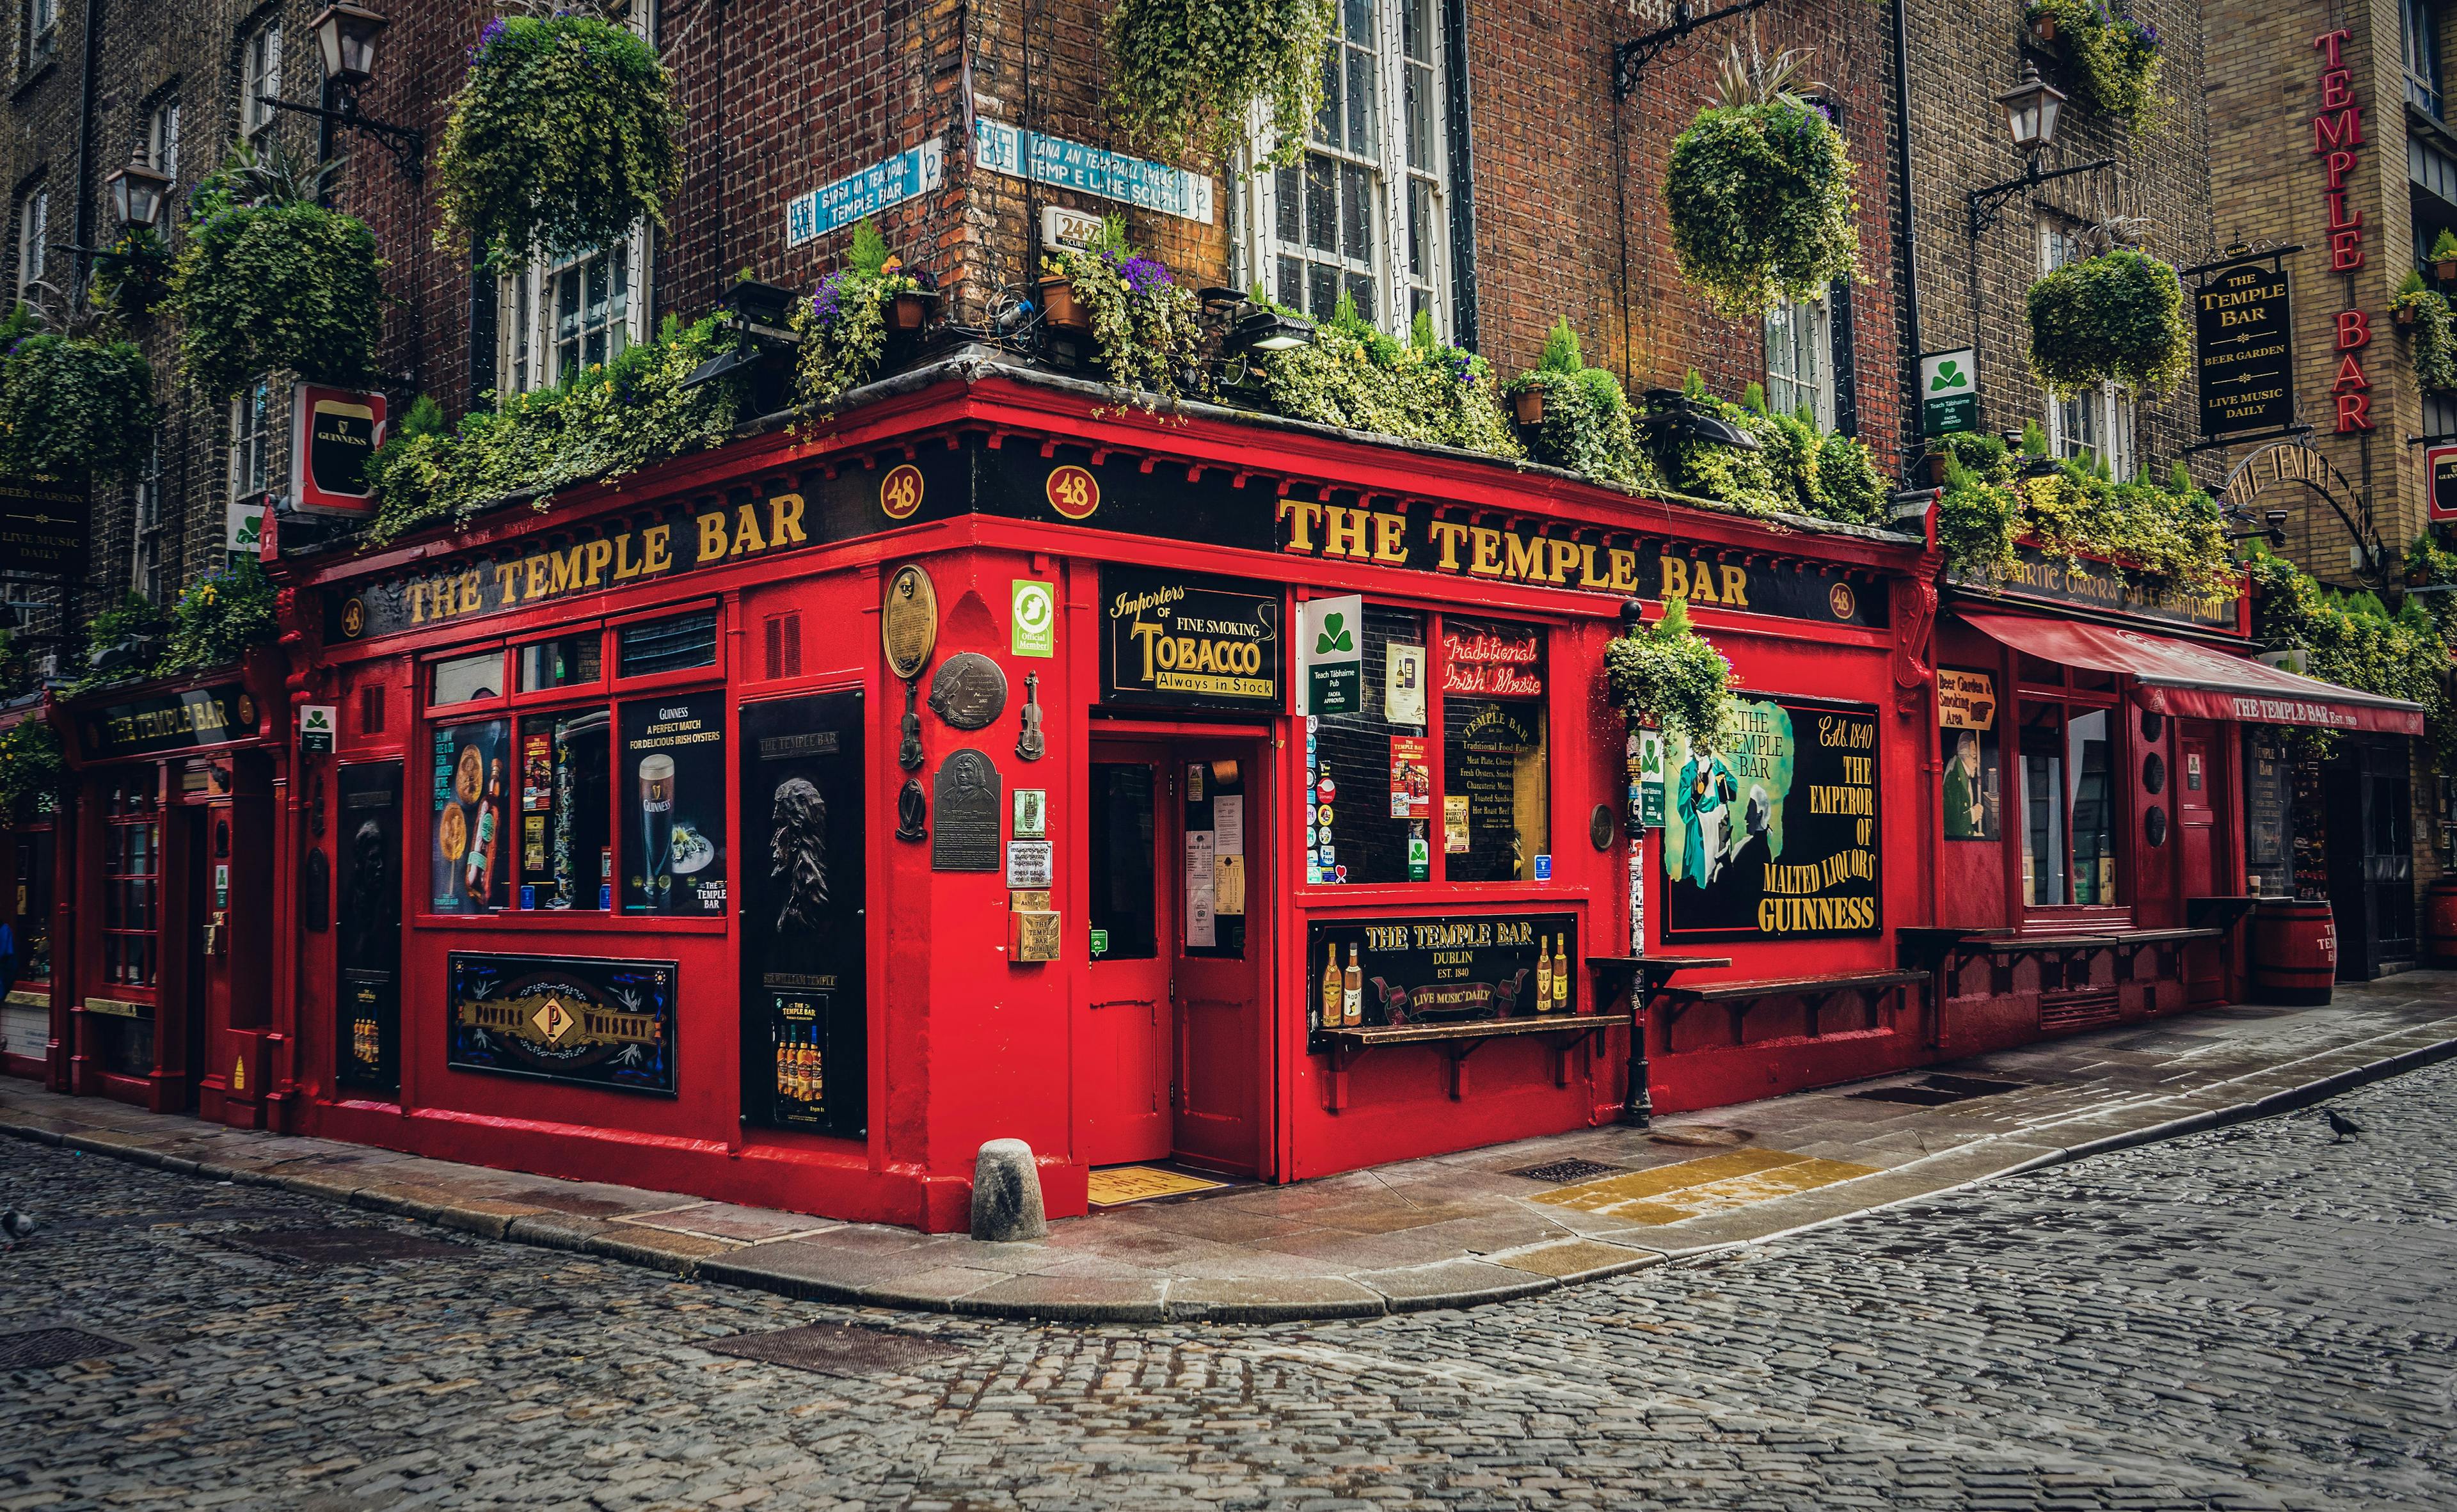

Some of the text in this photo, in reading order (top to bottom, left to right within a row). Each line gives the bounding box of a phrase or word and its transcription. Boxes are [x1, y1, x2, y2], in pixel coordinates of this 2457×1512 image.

[1031, 141, 1060, 160] LANA
[1065, 148, 1081, 164] AN
[926, 154, 937, 179] 2
[831, 194, 874, 223] TEMPLE
[1132, 186, 1179, 211] SOUTH
[1062, 218, 1098, 243] 24-7
[2310, 28, 2374, 434] TEMPLE BAR
[2227, 274, 2256, 287] THE
[2200, 283, 2286, 311] TEMPLE
[2221, 307, 2266, 327] BAR
[2204, 344, 2285, 366] BEER GARDEN
[2209, 388, 2283, 408] LIVE MUSIC
[2226, 404, 2266, 418] DAILY
[317, 432, 367, 446] GUINNESS
[2227, 458, 2264, 505] THE
[2268, 445, 2335, 492] TEMPLE
[0, 487, 84, 503] BEER GARDEN
[887, 475, 915, 509] 48
[1054, 476, 1089, 508] 48
[2, 532, 80, 548] LIVE MUSIC
[20, 548, 61, 560] DAILY
[406, 493, 807, 625] THE TEMPLE BAR
[1280, 499, 1749, 608] THE TEMPLE BAR
[1110, 585, 1184, 621] Importers
[1834, 590, 1850, 612] 48
[346, 606, 360, 629] 48
[1157, 608, 1170, 618] OF
[1022, 632, 1045, 642] Official
[1177, 617, 1260, 637] FINE SMOKING
[1019, 641, 1047, 649] Member
[1131, 621, 1261, 681] TOBACCO
[1443, 637, 1536, 661] Traditional
[1159, 673, 1271, 694] Always in Stock
[1442, 664, 1540, 694] Irish Music
[1939, 674, 1955, 690] Beer
[1958, 676, 1984, 694] Garden
[1939, 692, 1969, 712] Smoking
[2233, 697, 2259, 717] THE
[2260, 700, 2306, 722] TEMPLE
[2306, 704, 2330, 723] BAR
[107, 699, 229, 743] THE TEMPLE BAR
[659, 707, 688, 720] GUINNESS
[1738, 711, 1769, 733] THE
[1946, 710, 1963, 725] Area
[647, 720, 701, 735] A PERFECT MATCH
[1463, 712, 1528, 742] TEMPLE BAR
[1849, 721, 1873, 749] 1840
[630, 731, 720, 749] FOR DELICIOUS IRISH OYSTERS
[760, 732, 837, 751] THE TEMPLE BAR
[1463, 741, 1529, 752] Traditional Food Fare
[1726, 733, 1783, 757] TEMPLE
[1467, 756, 1479, 765] Meat
[1496, 758, 1512, 766] Cheese
[1738, 756, 1770, 780] BAR
[1843, 756, 1872, 784] THE
[1460, 768, 1474, 777] Fresh
[644, 799, 671, 813] GUINNESS
[1474, 793, 1493, 802] Toasted
[1809, 785, 1873, 816] EMPEROR
[1472, 806, 1483, 815] Hot
[1499, 807, 1510, 815] Beef
[1856, 818, 1873, 846] OF
[1763, 849, 1875, 895] MALTED LIQUORS
[697, 889, 727, 900] TEMPLE
[704, 899, 720, 909] BAR
[1758, 897, 1875, 932] GUINNESS
[1365, 921, 1534, 951] THE TEMPLE BAR
[1433, 951, 1473, 966] DUBLIN
[1437, 968, 1469, 979] EST. 1840
[1344, 990, 1362, 1000] PADDY
[1413, 989, 1491, 1007] LIVE MUSIC DAILY
[475, 1005, 647, 1037] POWERS P WHISKEY
[804, 1008, 816, 1017] BAR
